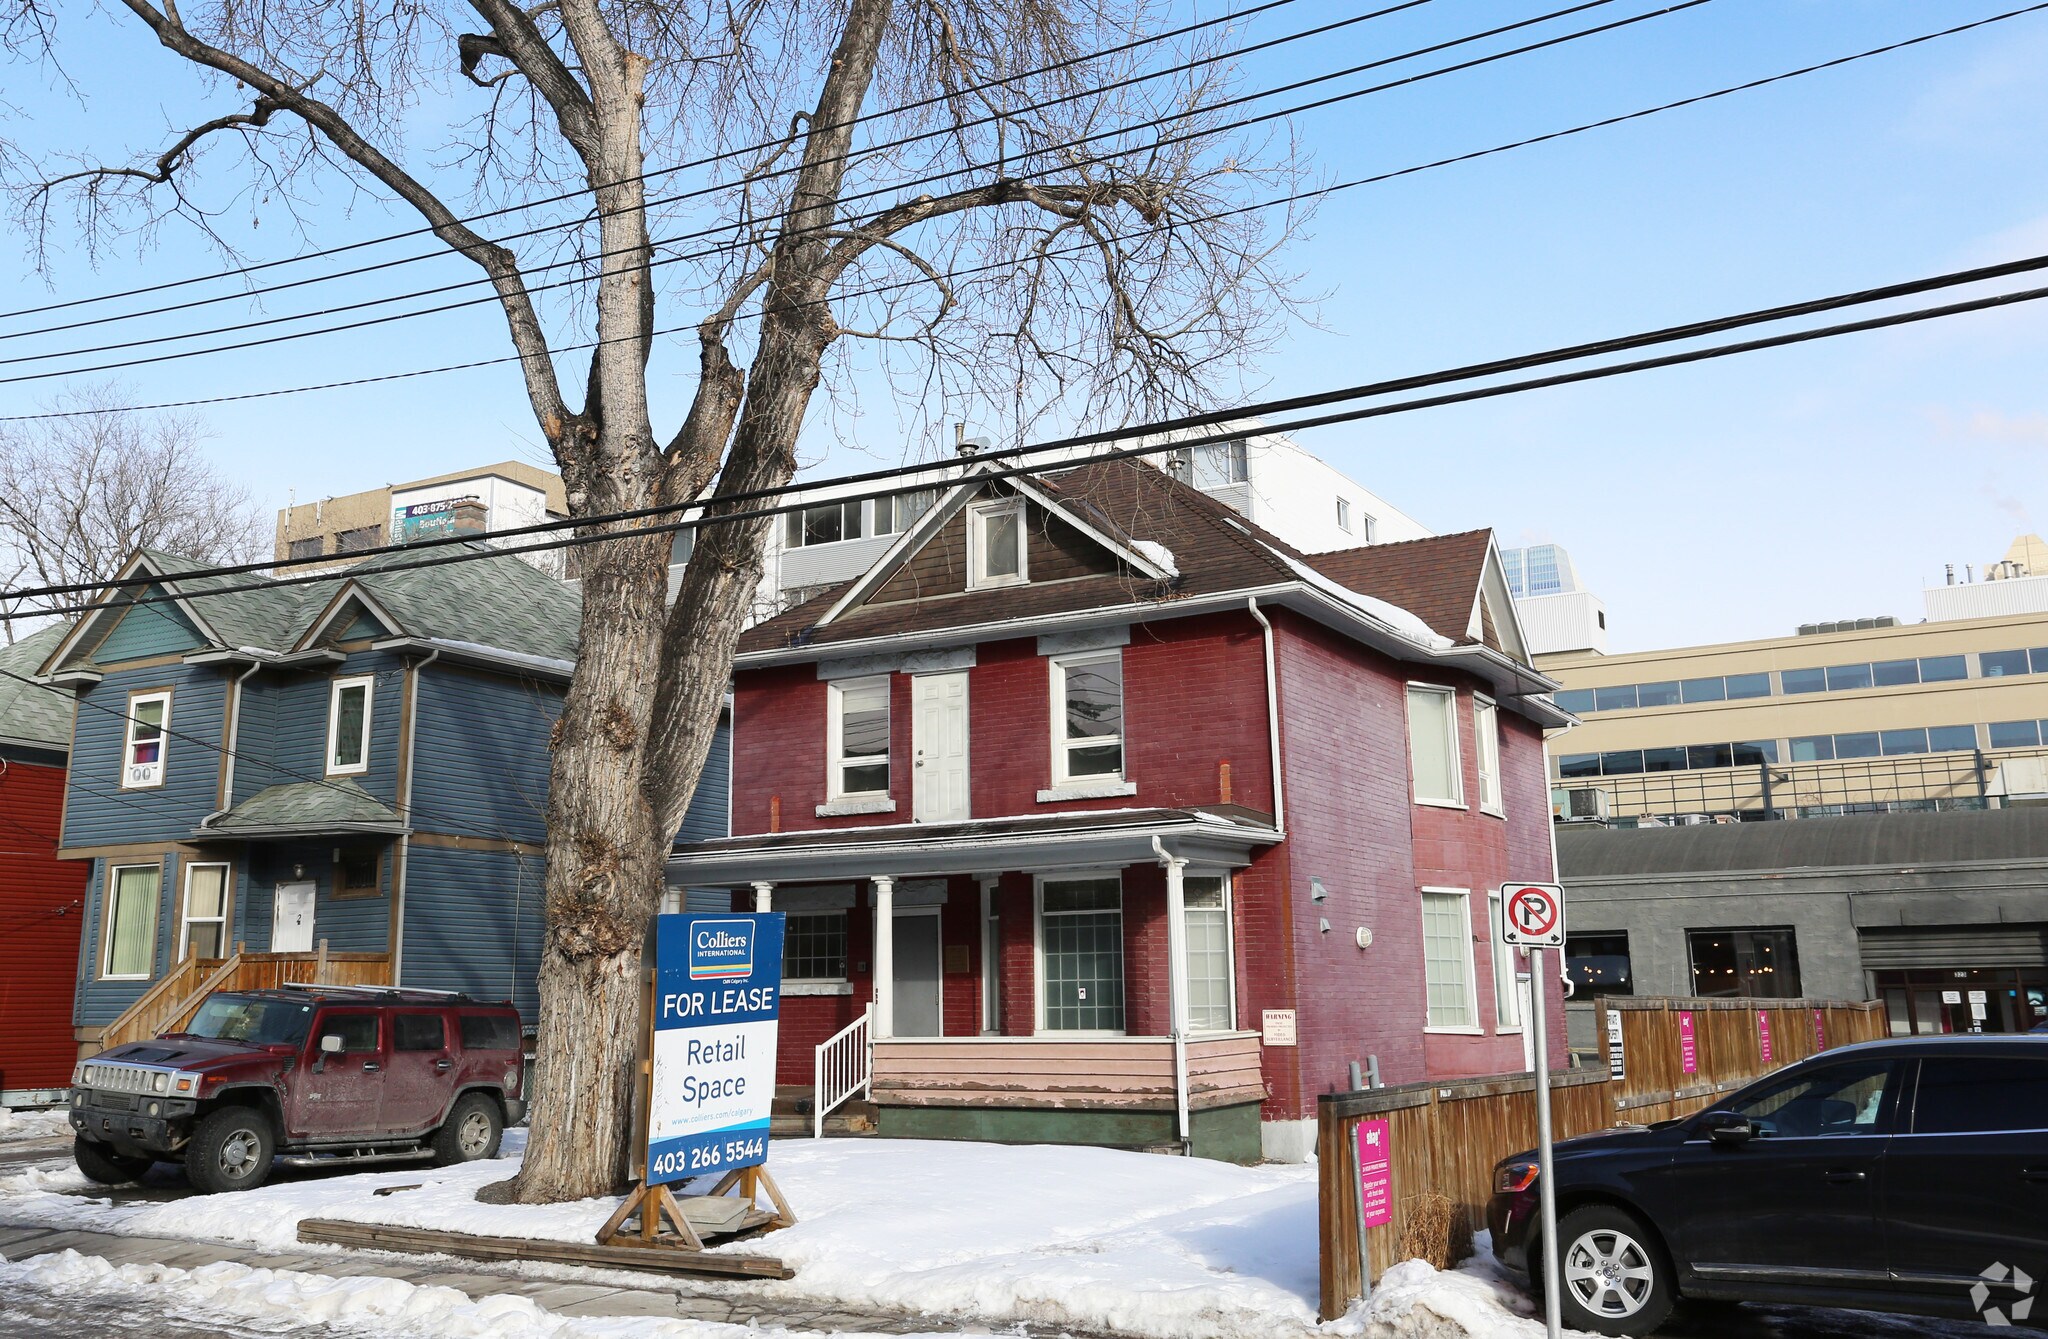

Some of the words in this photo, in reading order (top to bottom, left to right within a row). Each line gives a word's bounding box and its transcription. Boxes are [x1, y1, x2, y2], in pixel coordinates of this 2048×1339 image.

[697, 931, 747, 949] Colliers
[664, 992, 704, 1018] FOR
[711, 987, 774, 1014] LEASE
[687, 1034, 745, 1066] Retail
[682, 1075, 746, 1109] Space
[672, 1108, 753, 1125] www.colliers.com/calgary
[653, 1150, 686, 1175] 403
[691, 1144, 721, 1169] 266
[725, 1137, 763, 1163] 5544
